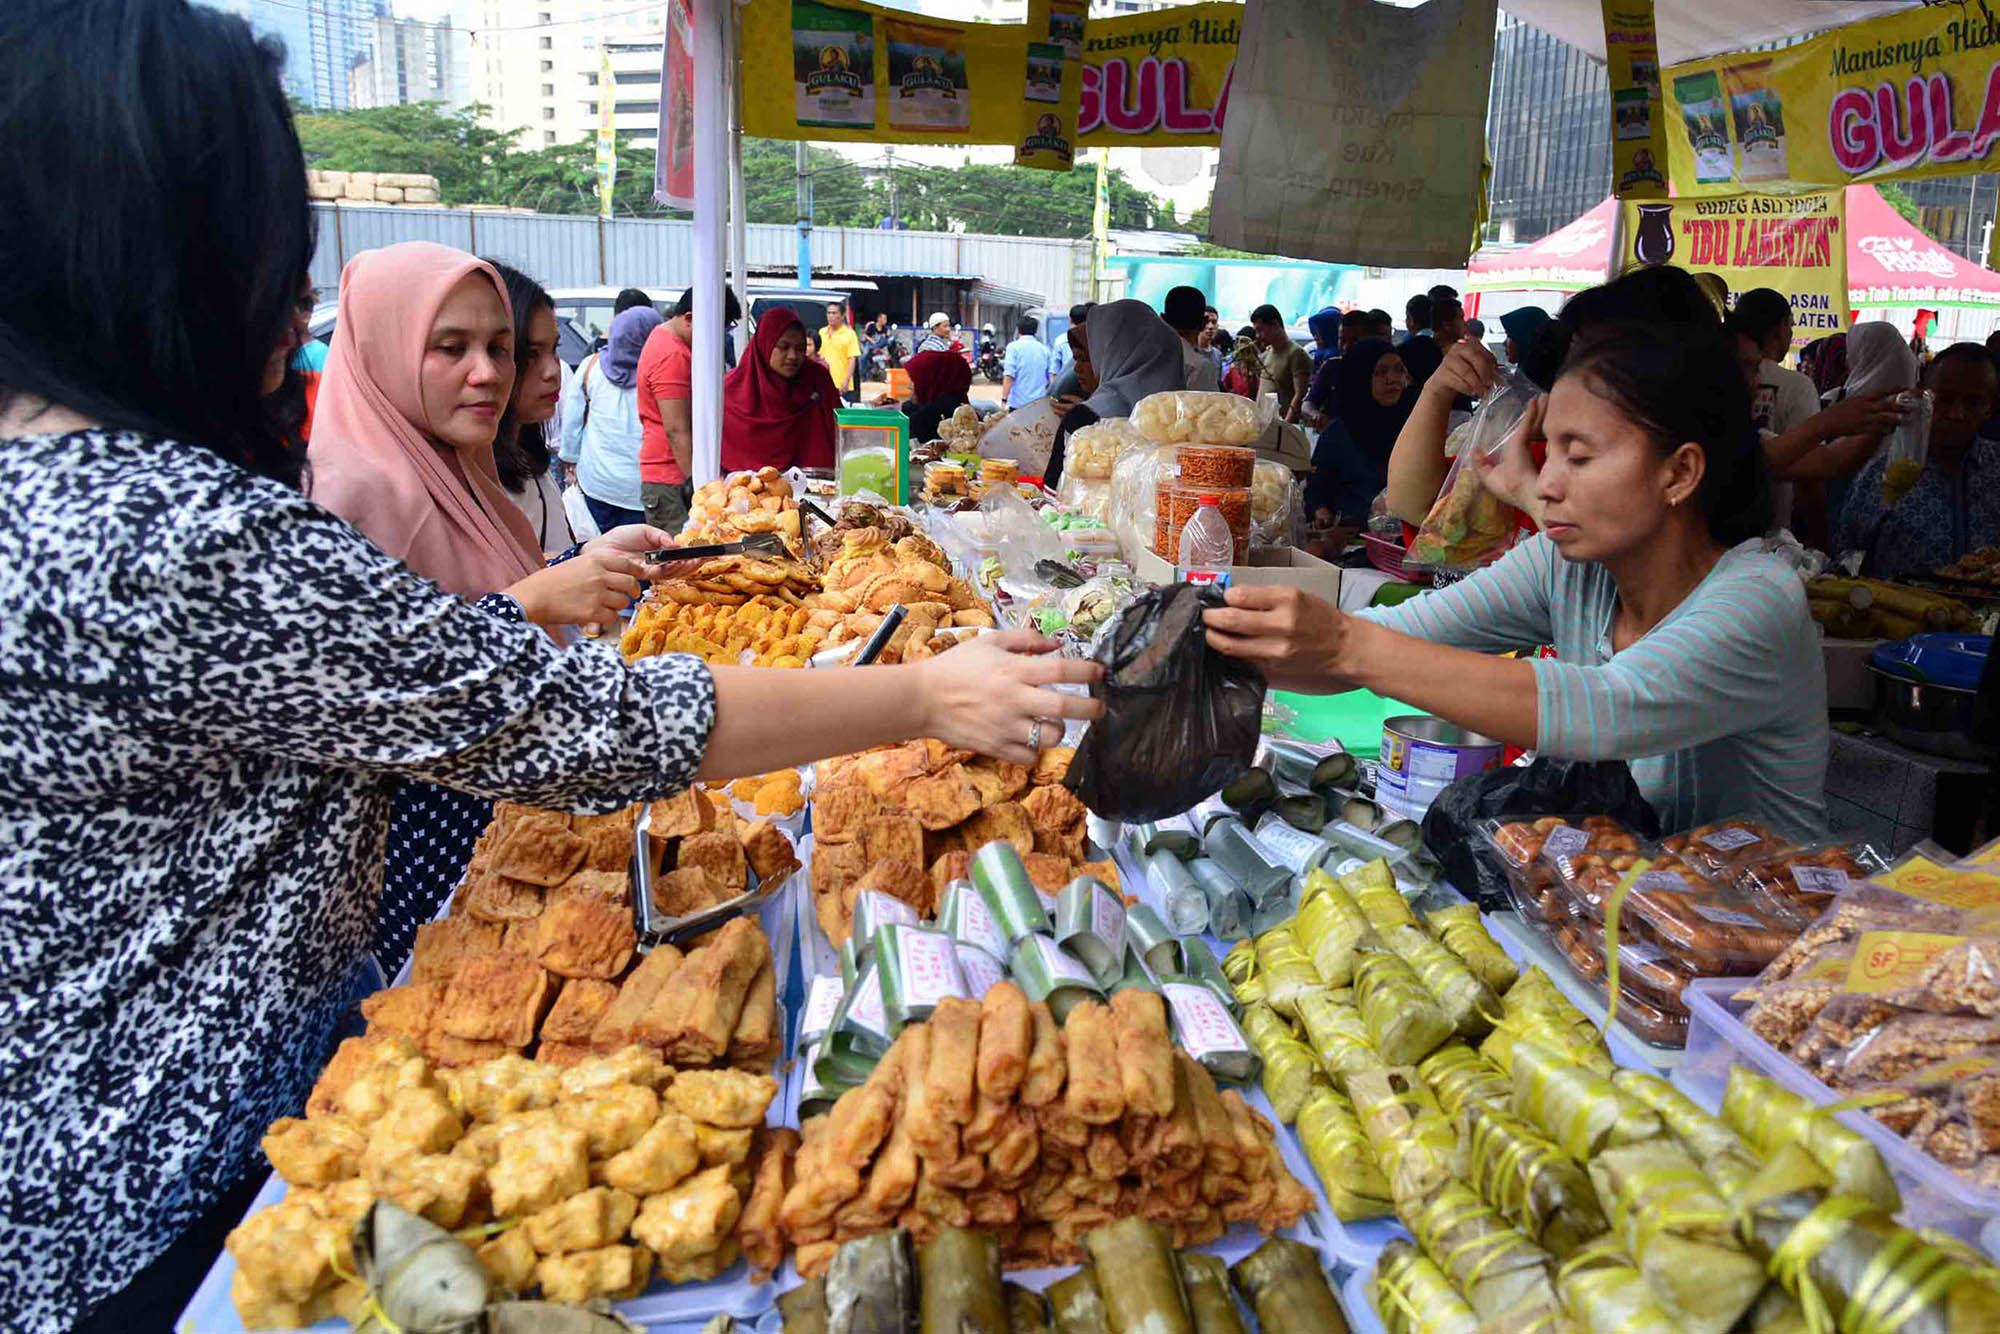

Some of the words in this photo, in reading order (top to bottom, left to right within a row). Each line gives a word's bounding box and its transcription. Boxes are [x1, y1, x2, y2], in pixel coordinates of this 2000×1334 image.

[1086, 26, 1182, 56] nisnya
[1830, 36, 1942, 76] Manisnya
[1076, 55, 1236, 136] UL
[1695, 199, 1748, 214] GUDEG
[1751, 198, 1784, 214] ASLI
[1791, 312, 1839, 328] LATEN
[1869, 950, 1896, 969] SF
